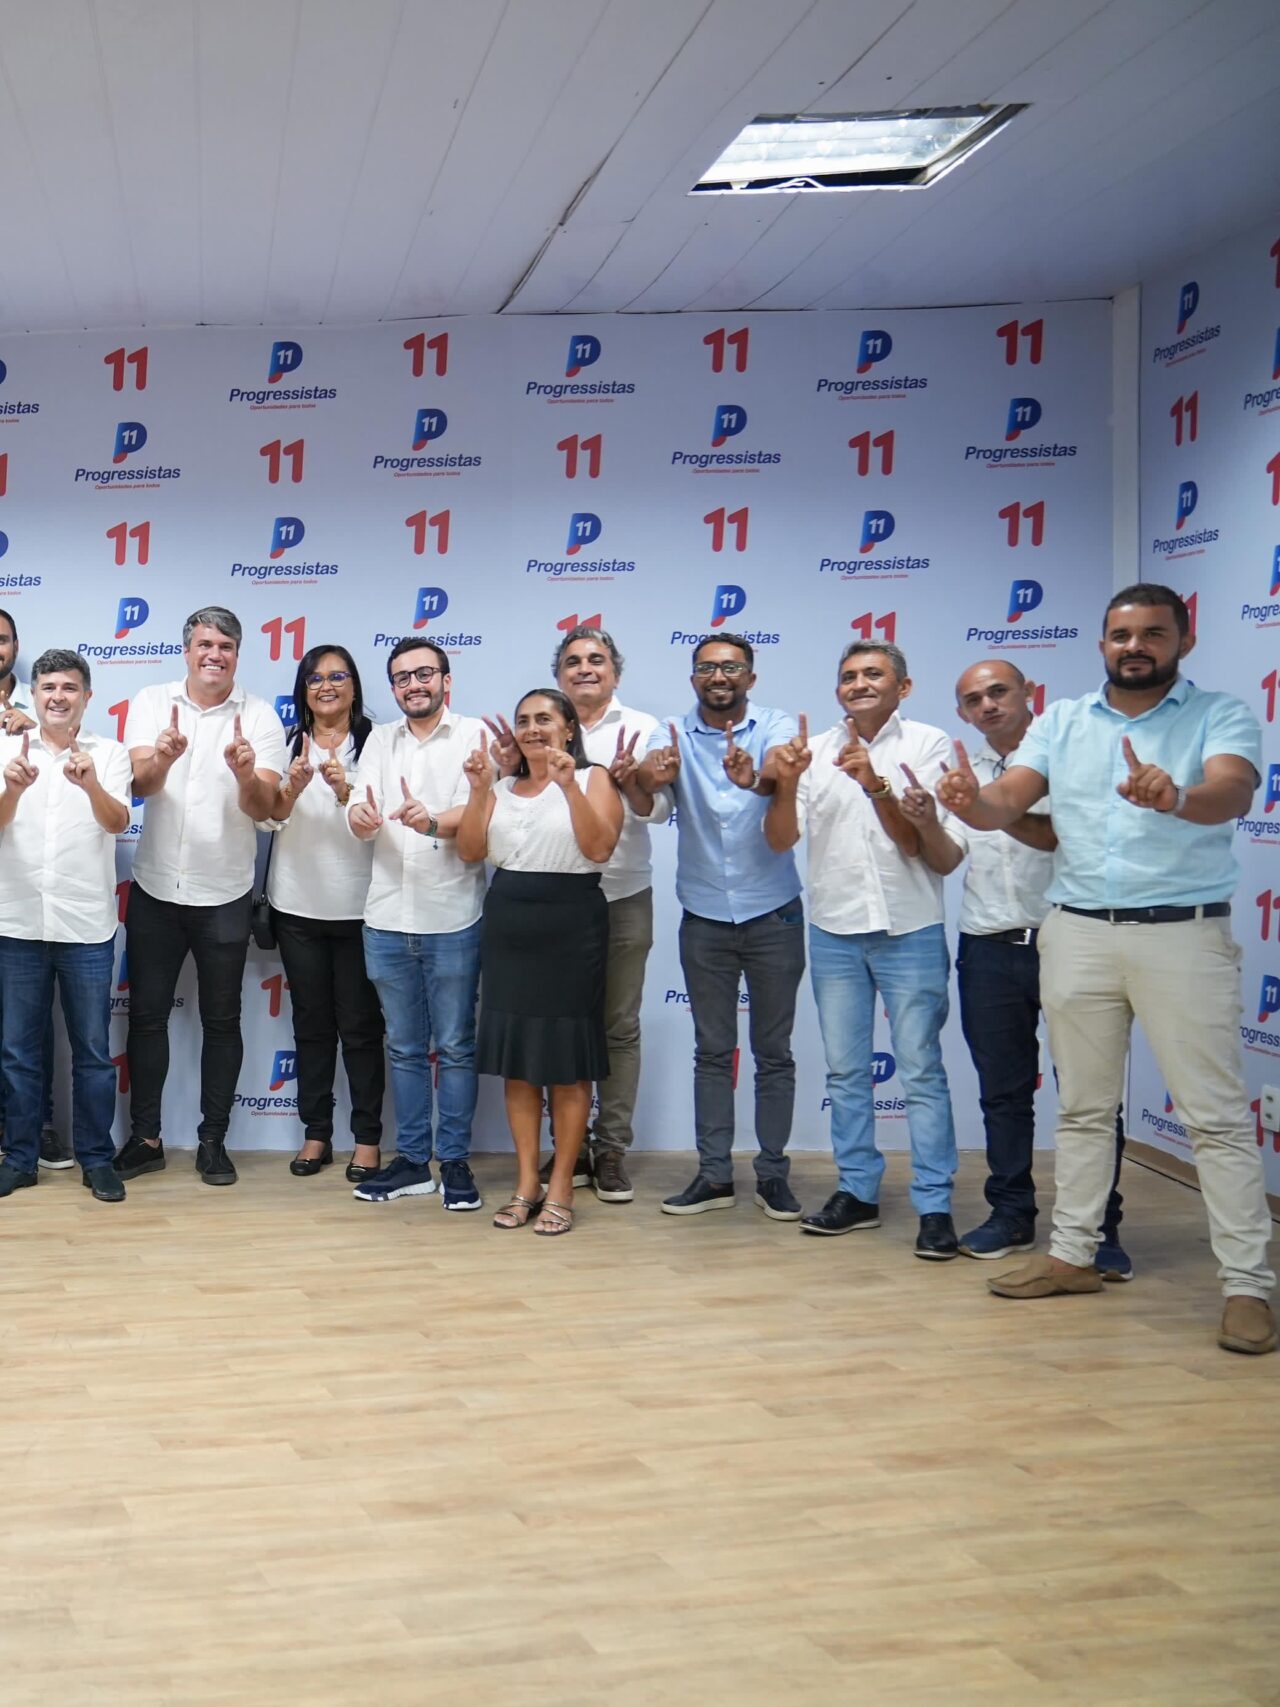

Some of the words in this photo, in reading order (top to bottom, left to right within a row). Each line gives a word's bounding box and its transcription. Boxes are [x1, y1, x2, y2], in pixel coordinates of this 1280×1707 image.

[576, 344, 591, 358] 11
[703, 327, 750, 373] 11
[866, 339, 882, 354] 11
[997, 319, 1044, 365] 11
[1152, 324, 1221, 364] Progressistas
[278, 350, 293, 364] 11
[403, 332, 449, 377] 11
[103, 346, 149, 392] 11
[525, 380, 636, 398] Progressistas
[816, 375, 928, 395] Progressistas
[229, 386, 337, 405] Progressistas
[721, 413, 737, 428] 11
[1016, 406, 1031, 421] 11
[1172, 393, 1199, 443] 11
[422, 417, 437, 431] 11
[122, 430, 137, 444] 11
[259, 439, 305, 484] 11
[557, 434, 602, 479] 11
[671, 450, 782, 468] Progressistas
[849, 431, 895, 476] 11
[964, 443, 1078, 463] Progressistas
[372, 454, 482, 472] Progressistas
[74, 466, 181, 484] Progressistas
[1182, 490, 1191, 507] 11
[280, 525, 294, 540] 11
[406, 510, 451, 555] 11
[576, 521, 591, 536] 11
[704, 507, 749, 552] 11
[869, 519, 885, 533] 11
[999, 501, 1045, 547] 11
[106, 521, 151, 566] 11
[1152, 527, 1220, 555] Progressistas
[230, 561, 339, 580] Progressistas
[526, 559, 636, 576] Progressistas
[819, 555, 930, 575] Progressistas
[423, 596, 438, 610] 11
[720, 593, 736, 608] 11
[1017, 588, 1033, 603] 11
[124, 606, 139, 620] 11
[261, 616, 306, 662] 11
[966, 625, 1079, 644] Progressistas
[77, 641, 183, 660] Progressistas
[280, 703, 295, 718] 11
[279, 1058, 295, 1073] 11
